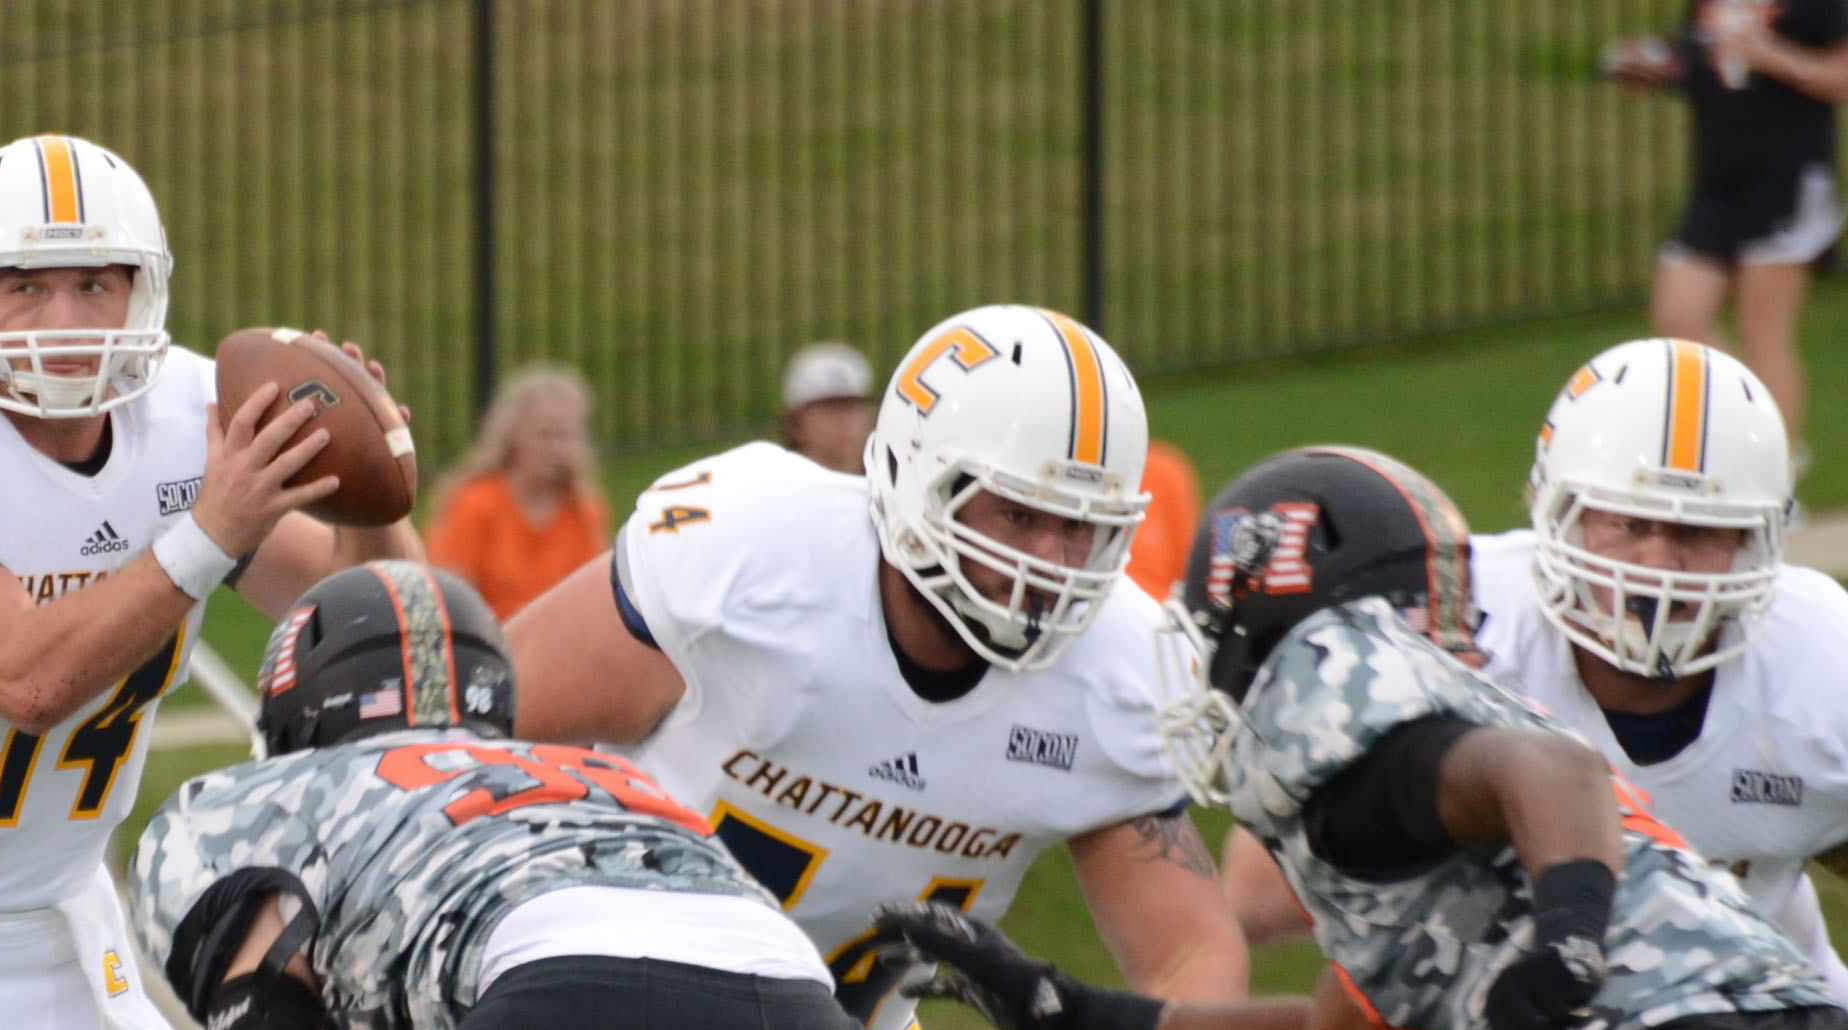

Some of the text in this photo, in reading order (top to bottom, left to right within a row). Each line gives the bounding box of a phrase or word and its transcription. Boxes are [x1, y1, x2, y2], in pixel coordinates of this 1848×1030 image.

[896, 324, 1002, 418] C
[646, 471, 713, 535] 74
[80, 538, 130, 556] adidas
[1006, 725, 1079, 772] SOCON
[720, 747, 1025, 861] CHATTANOOGA
[103, 948, 130, 999] C
